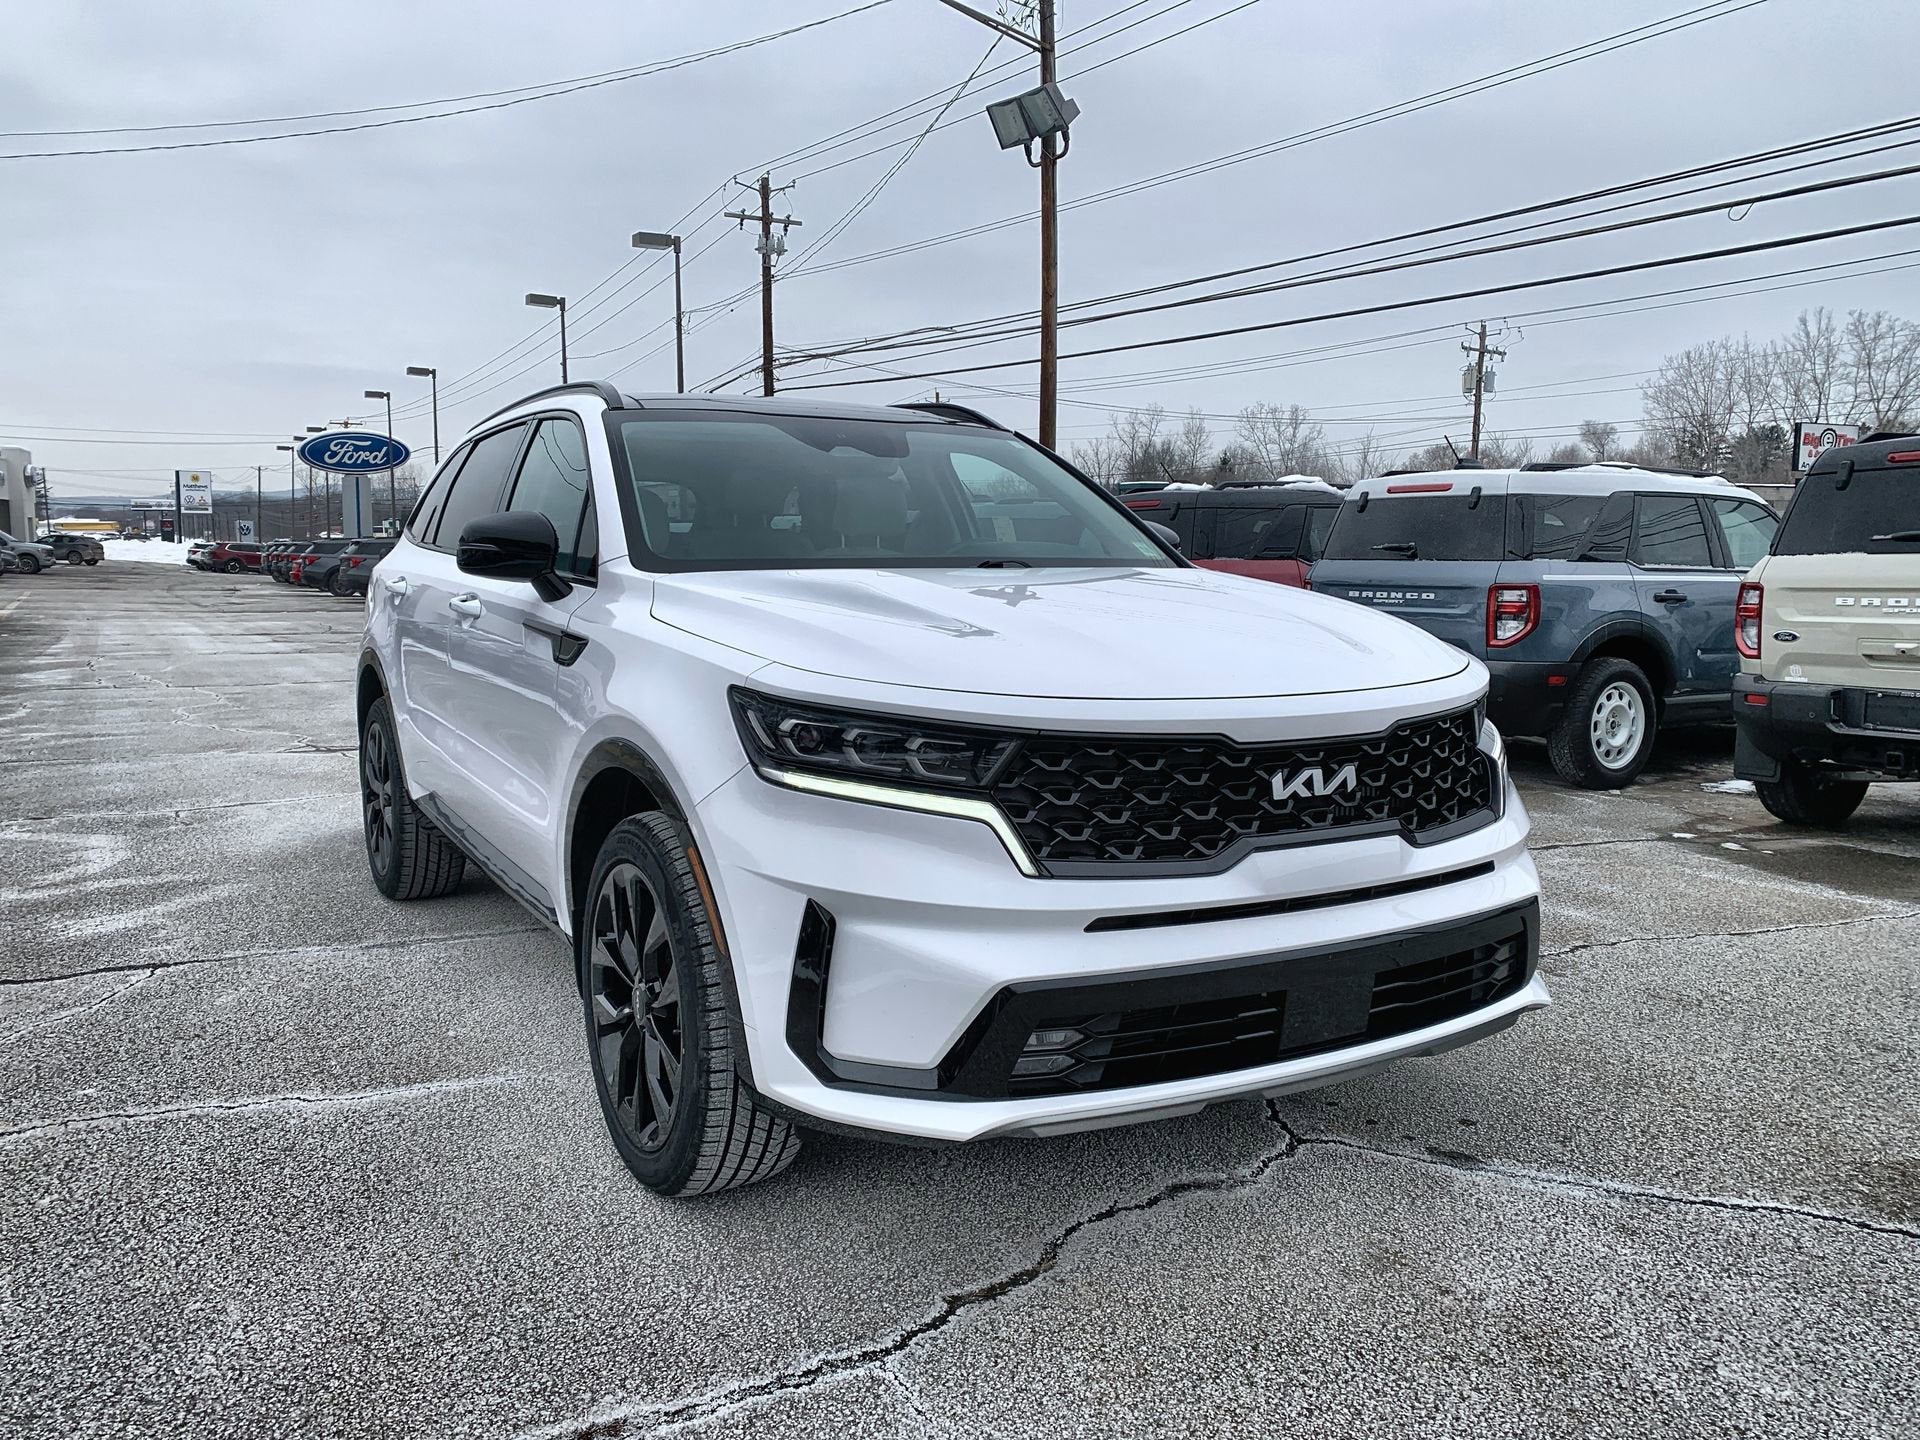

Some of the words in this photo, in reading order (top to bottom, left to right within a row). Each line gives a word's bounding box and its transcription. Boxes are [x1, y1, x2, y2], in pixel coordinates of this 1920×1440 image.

[1802, 432, 1820, 449] Big
[324, 440, 388, 464] Ford
[1348, 590, 1435, 600] BRONCO
[1835, 597, 1920, 606] BRO
[1271, 765, 1357, 800] KIA
